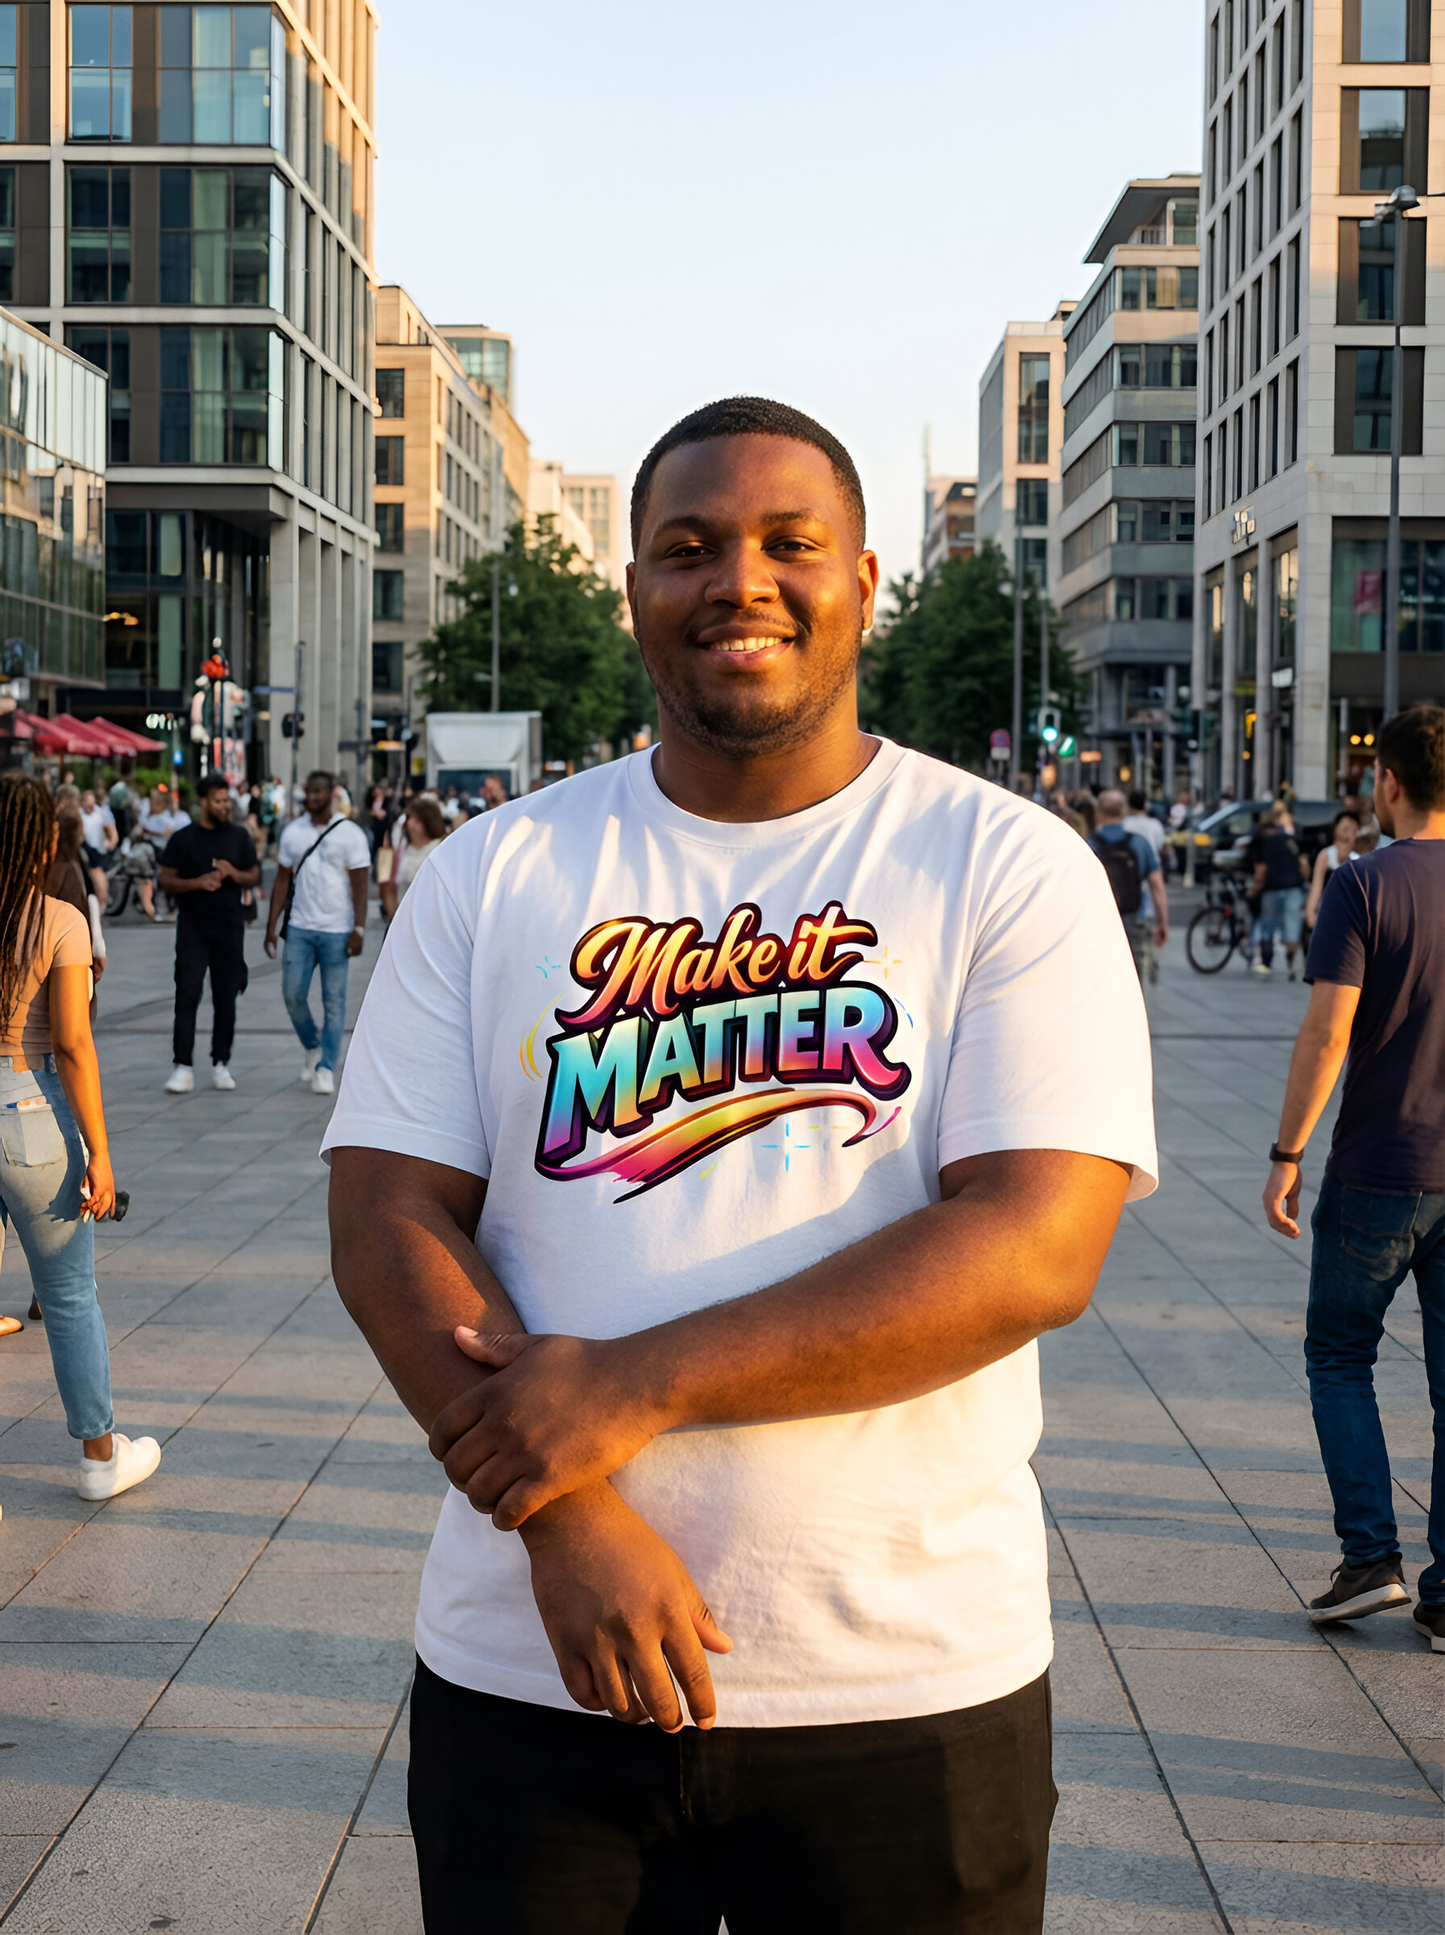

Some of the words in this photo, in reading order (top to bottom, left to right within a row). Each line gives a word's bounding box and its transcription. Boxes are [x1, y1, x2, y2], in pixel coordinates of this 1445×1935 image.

[555, 904, 782, 1025] Make
[788, 902, 877, 984] it
[540, 984, 908, 1158] MATTER
